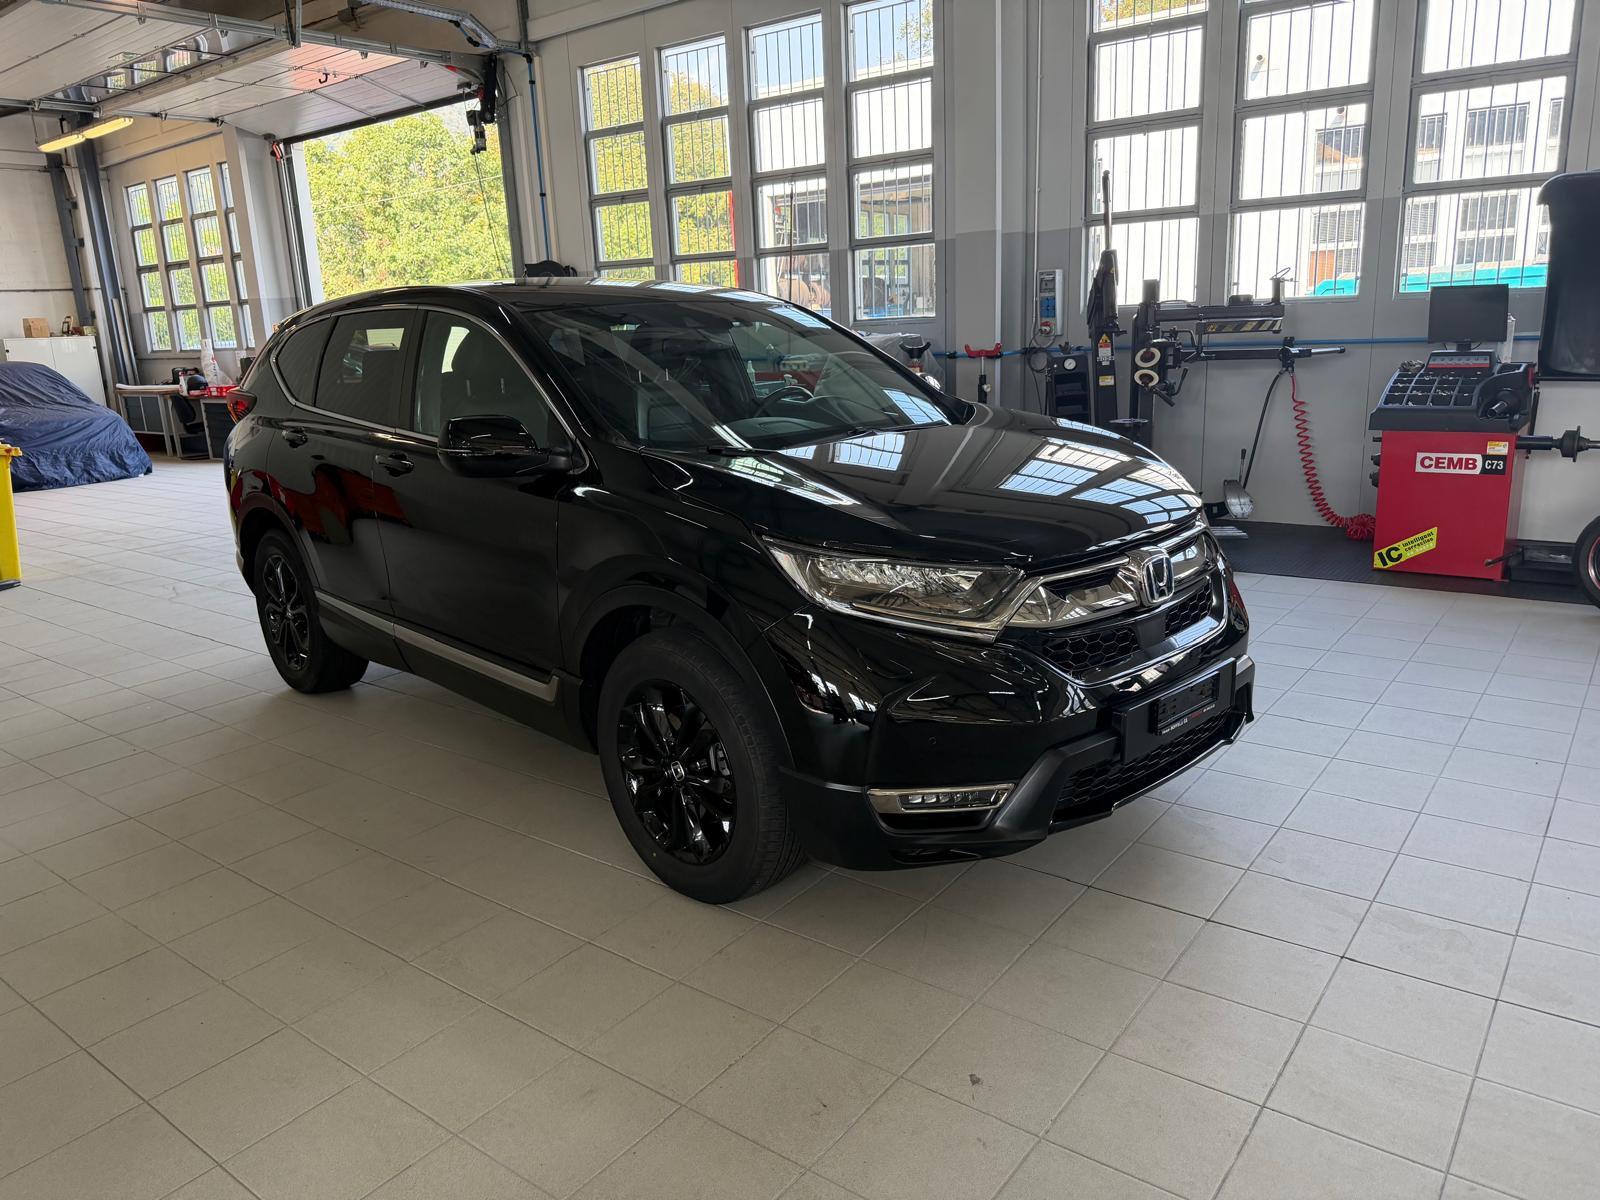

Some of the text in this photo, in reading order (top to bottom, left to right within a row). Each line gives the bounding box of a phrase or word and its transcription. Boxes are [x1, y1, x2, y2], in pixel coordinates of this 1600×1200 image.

[1419, 455, 1504, 471] CEMB C73
[1377, 546, 1403, 567] IC
